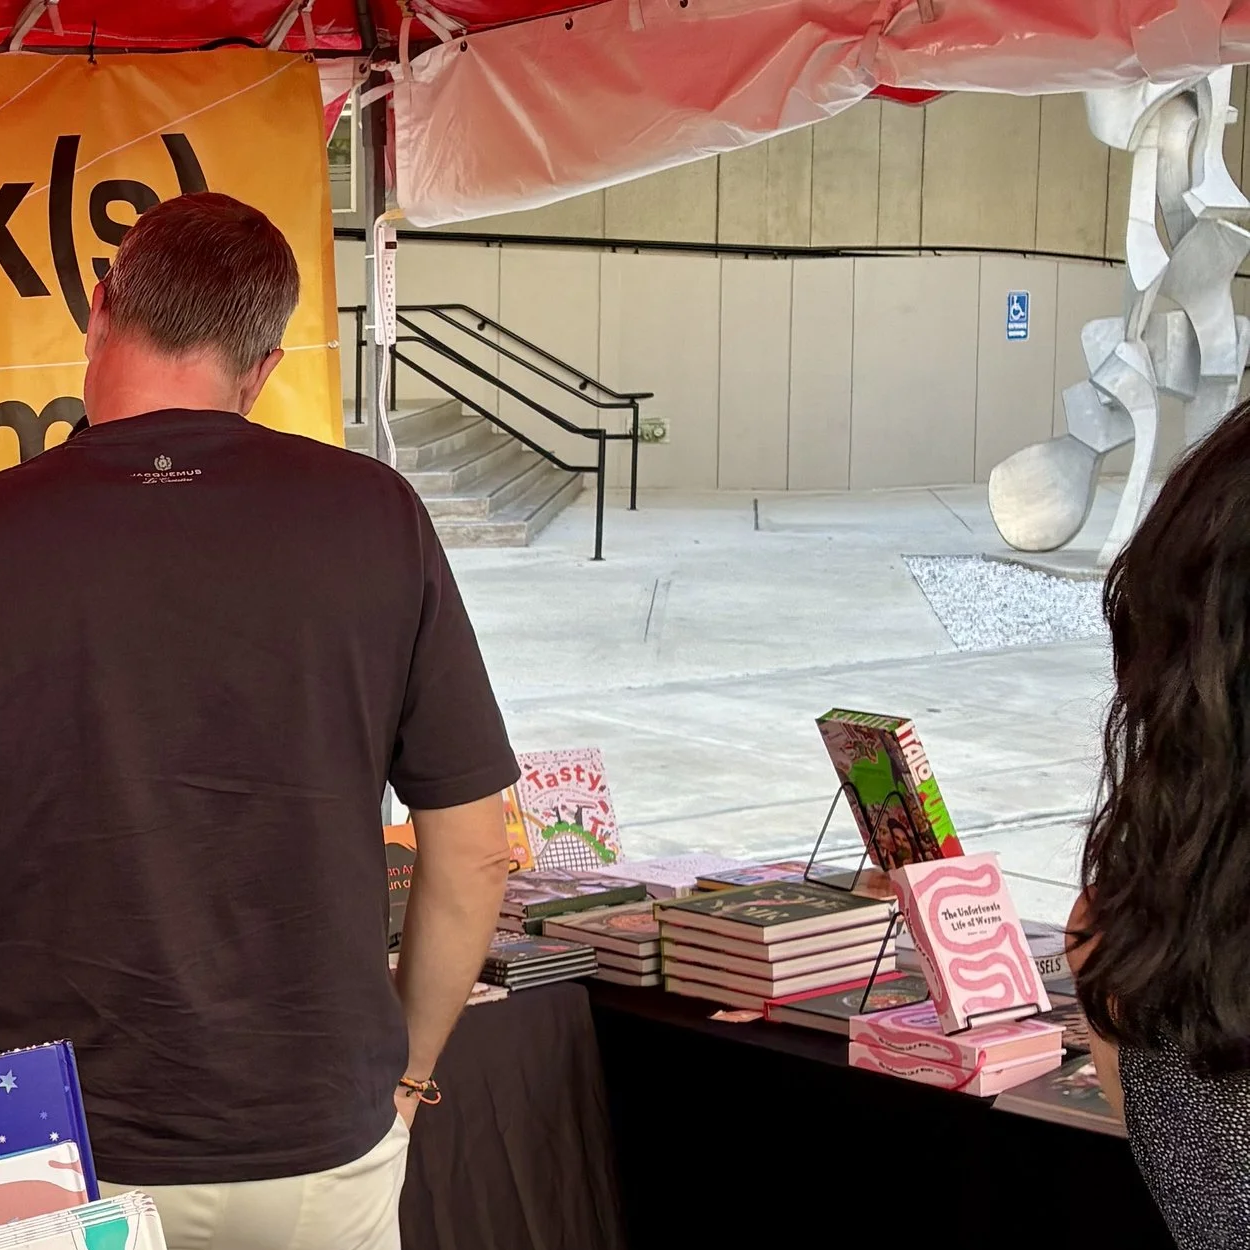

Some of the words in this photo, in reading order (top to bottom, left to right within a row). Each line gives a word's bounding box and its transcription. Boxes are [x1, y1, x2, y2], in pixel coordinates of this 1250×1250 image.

[895, 719, 934, 785] ITALO
[526, 764, 602, 791] Tasty
[942, 908, 957, 920] The
[951, 920, 966, 931] Life
